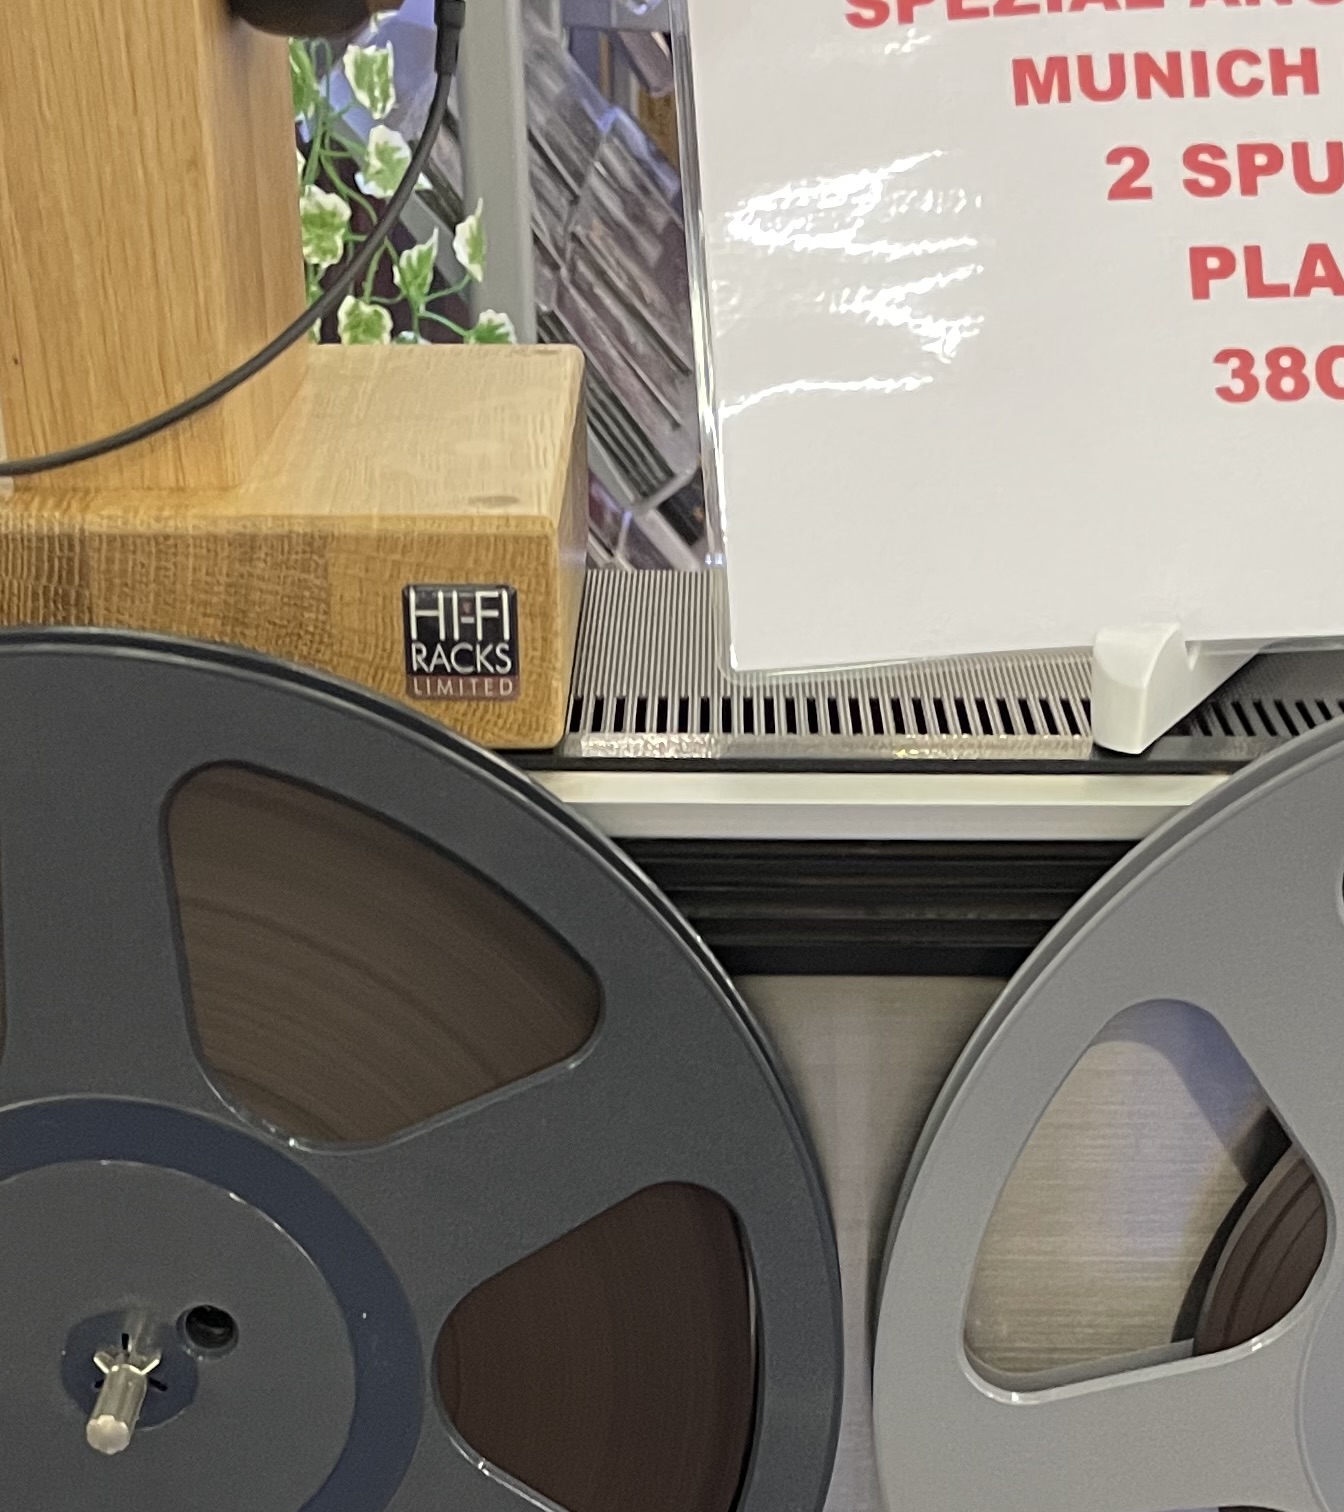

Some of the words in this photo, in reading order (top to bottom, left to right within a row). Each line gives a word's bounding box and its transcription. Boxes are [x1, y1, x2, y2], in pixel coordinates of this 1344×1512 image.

[1012, 47, 1319, 106] MUNICH
[1105, 146, 1153, 201] 2
[409, 586, 510, 641] HI-FI
[411, 642, 512, 674] RACKS
[413, 677, 513, 697] LIMITED
